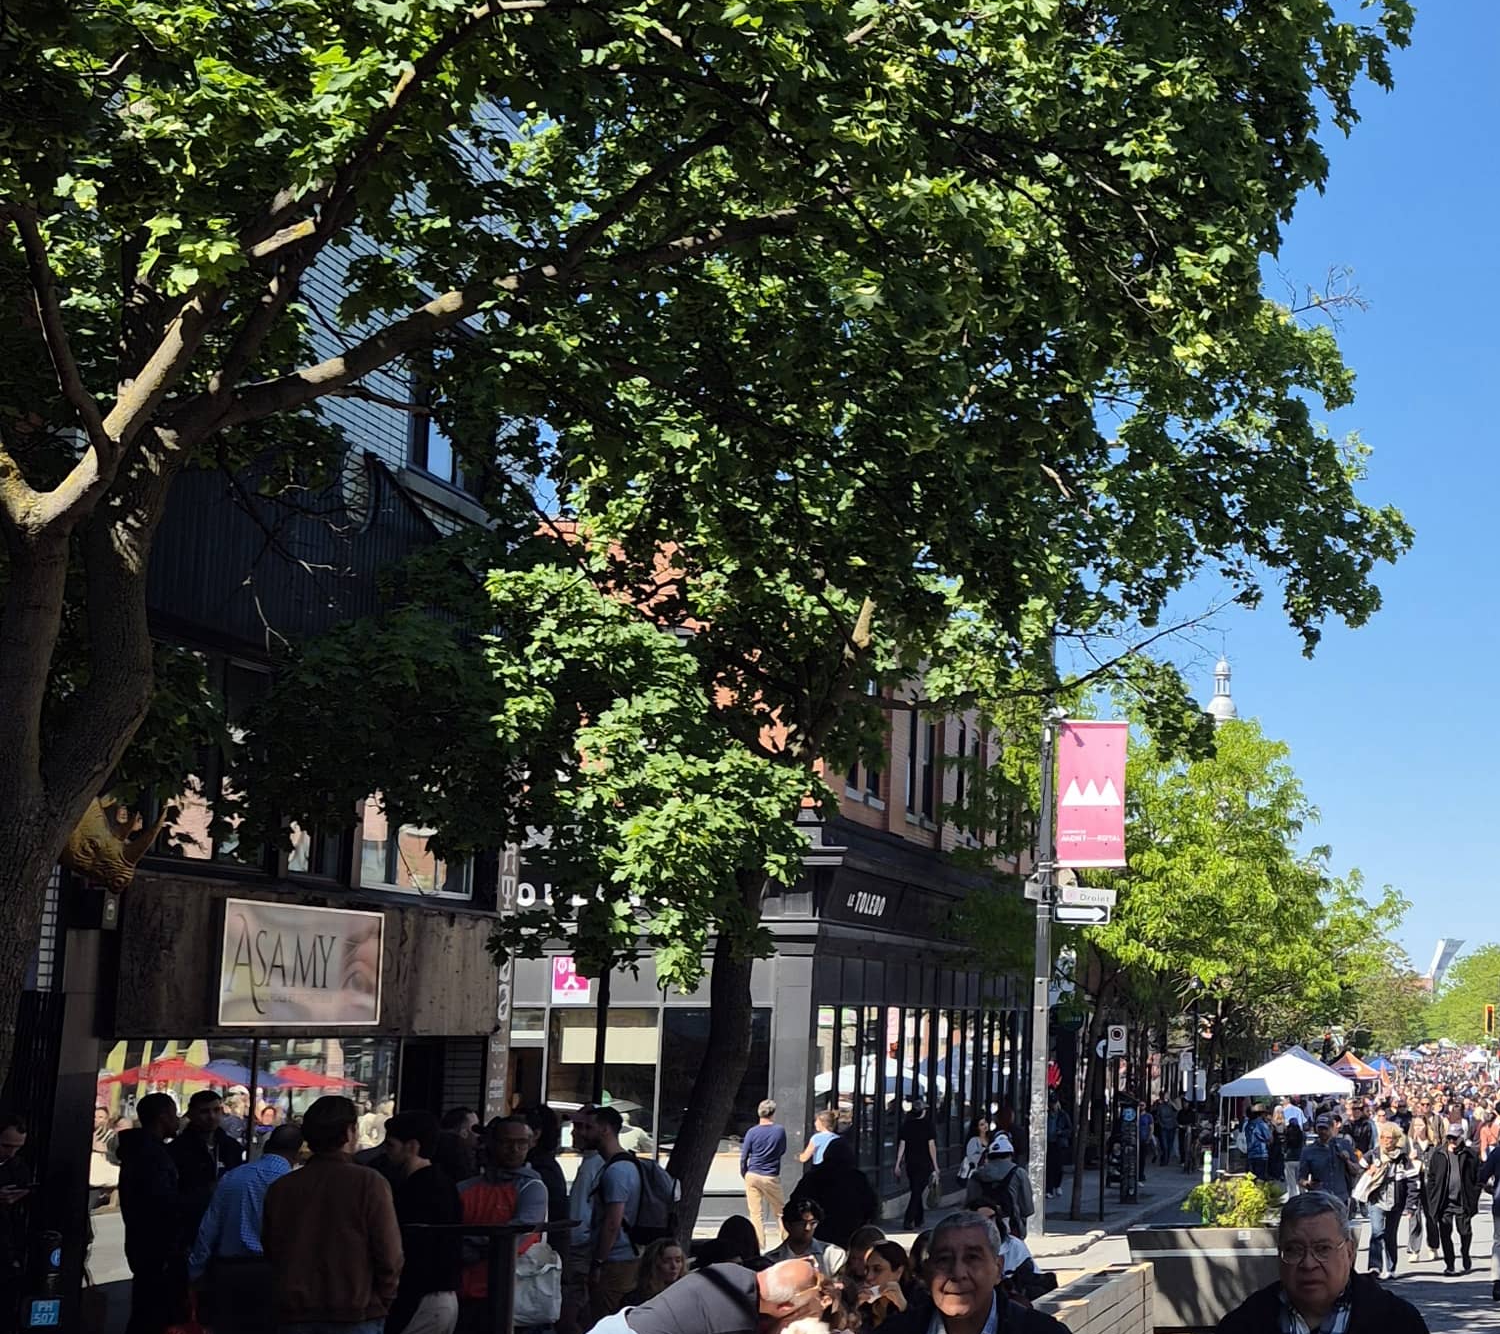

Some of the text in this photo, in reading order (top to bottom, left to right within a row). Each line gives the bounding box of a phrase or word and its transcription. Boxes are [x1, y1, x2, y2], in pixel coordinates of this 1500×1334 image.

[854, 890, 887, 917] TOLEDO
[223, 913, 337, 1015] ASAMY
[32, 1313, 56, 1325] 507
